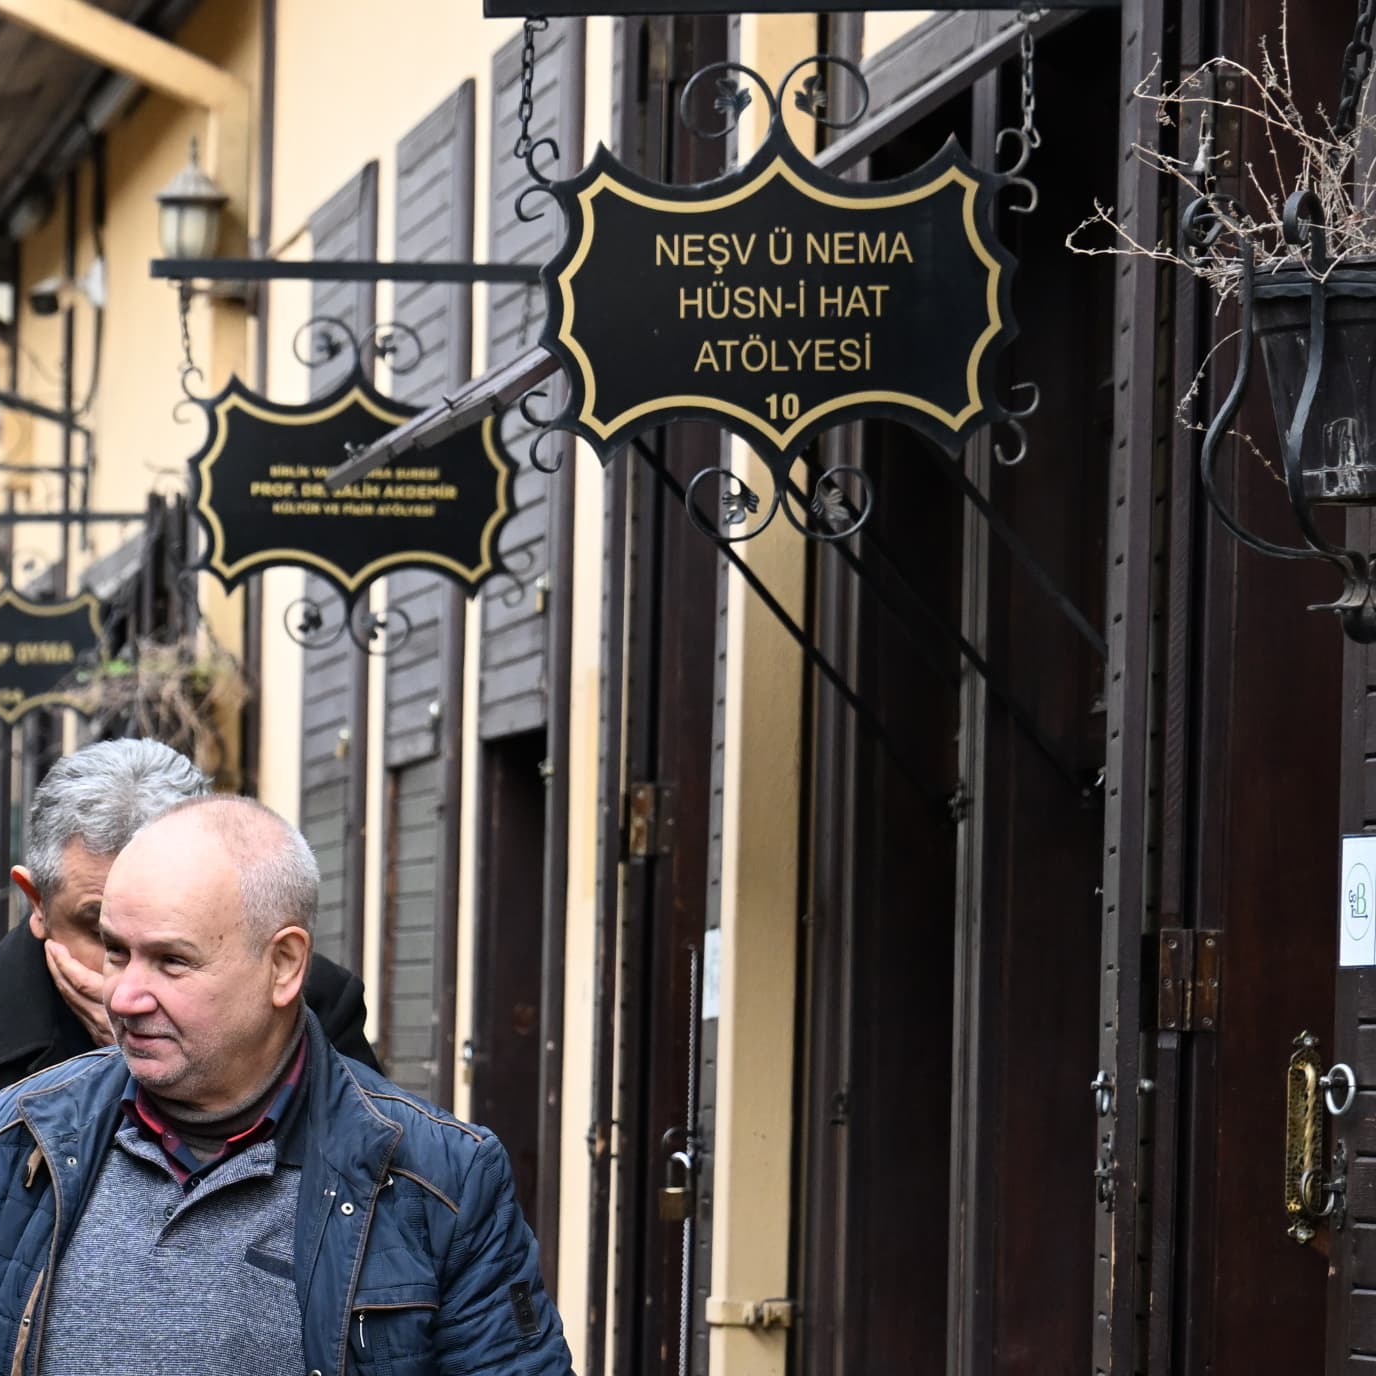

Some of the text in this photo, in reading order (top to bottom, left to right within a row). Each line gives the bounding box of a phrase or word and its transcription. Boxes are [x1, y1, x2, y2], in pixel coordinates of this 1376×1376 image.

[654, 226, 914, 275] NEŞV Ü NEMA
[678, 279, 890, 320] HÜSN-İ HAT
[693, 331, 872, 373] ATÖLYESİ
[765, 392, 800, 421] 10
[249, 480, 298, 498] PROF.
[300, 482, 329, 499] DR.
[382, 482, 460, 501] AKDEMİR
